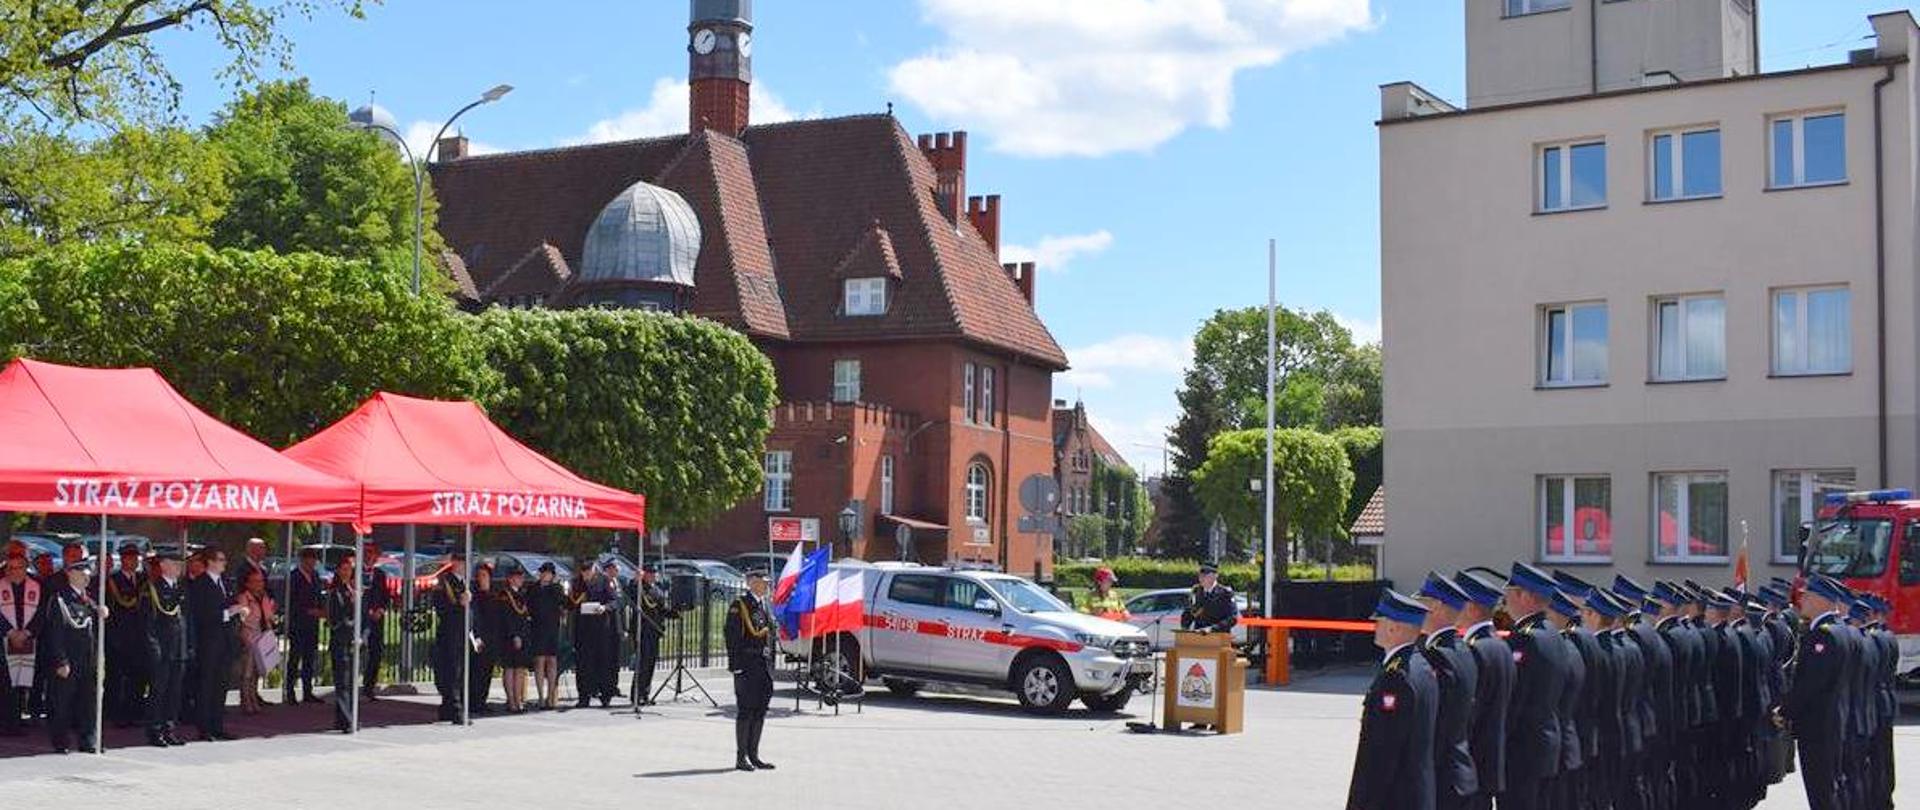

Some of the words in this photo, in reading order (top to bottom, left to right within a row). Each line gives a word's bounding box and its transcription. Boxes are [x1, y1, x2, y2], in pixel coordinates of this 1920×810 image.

[55, 478, 139, 507] STRAŻ
[149, 479, 280, 513] POŻARNA
[431, 489, 492, 515] STRAŻ
[497, 491, 588, 519] POŻARNA
